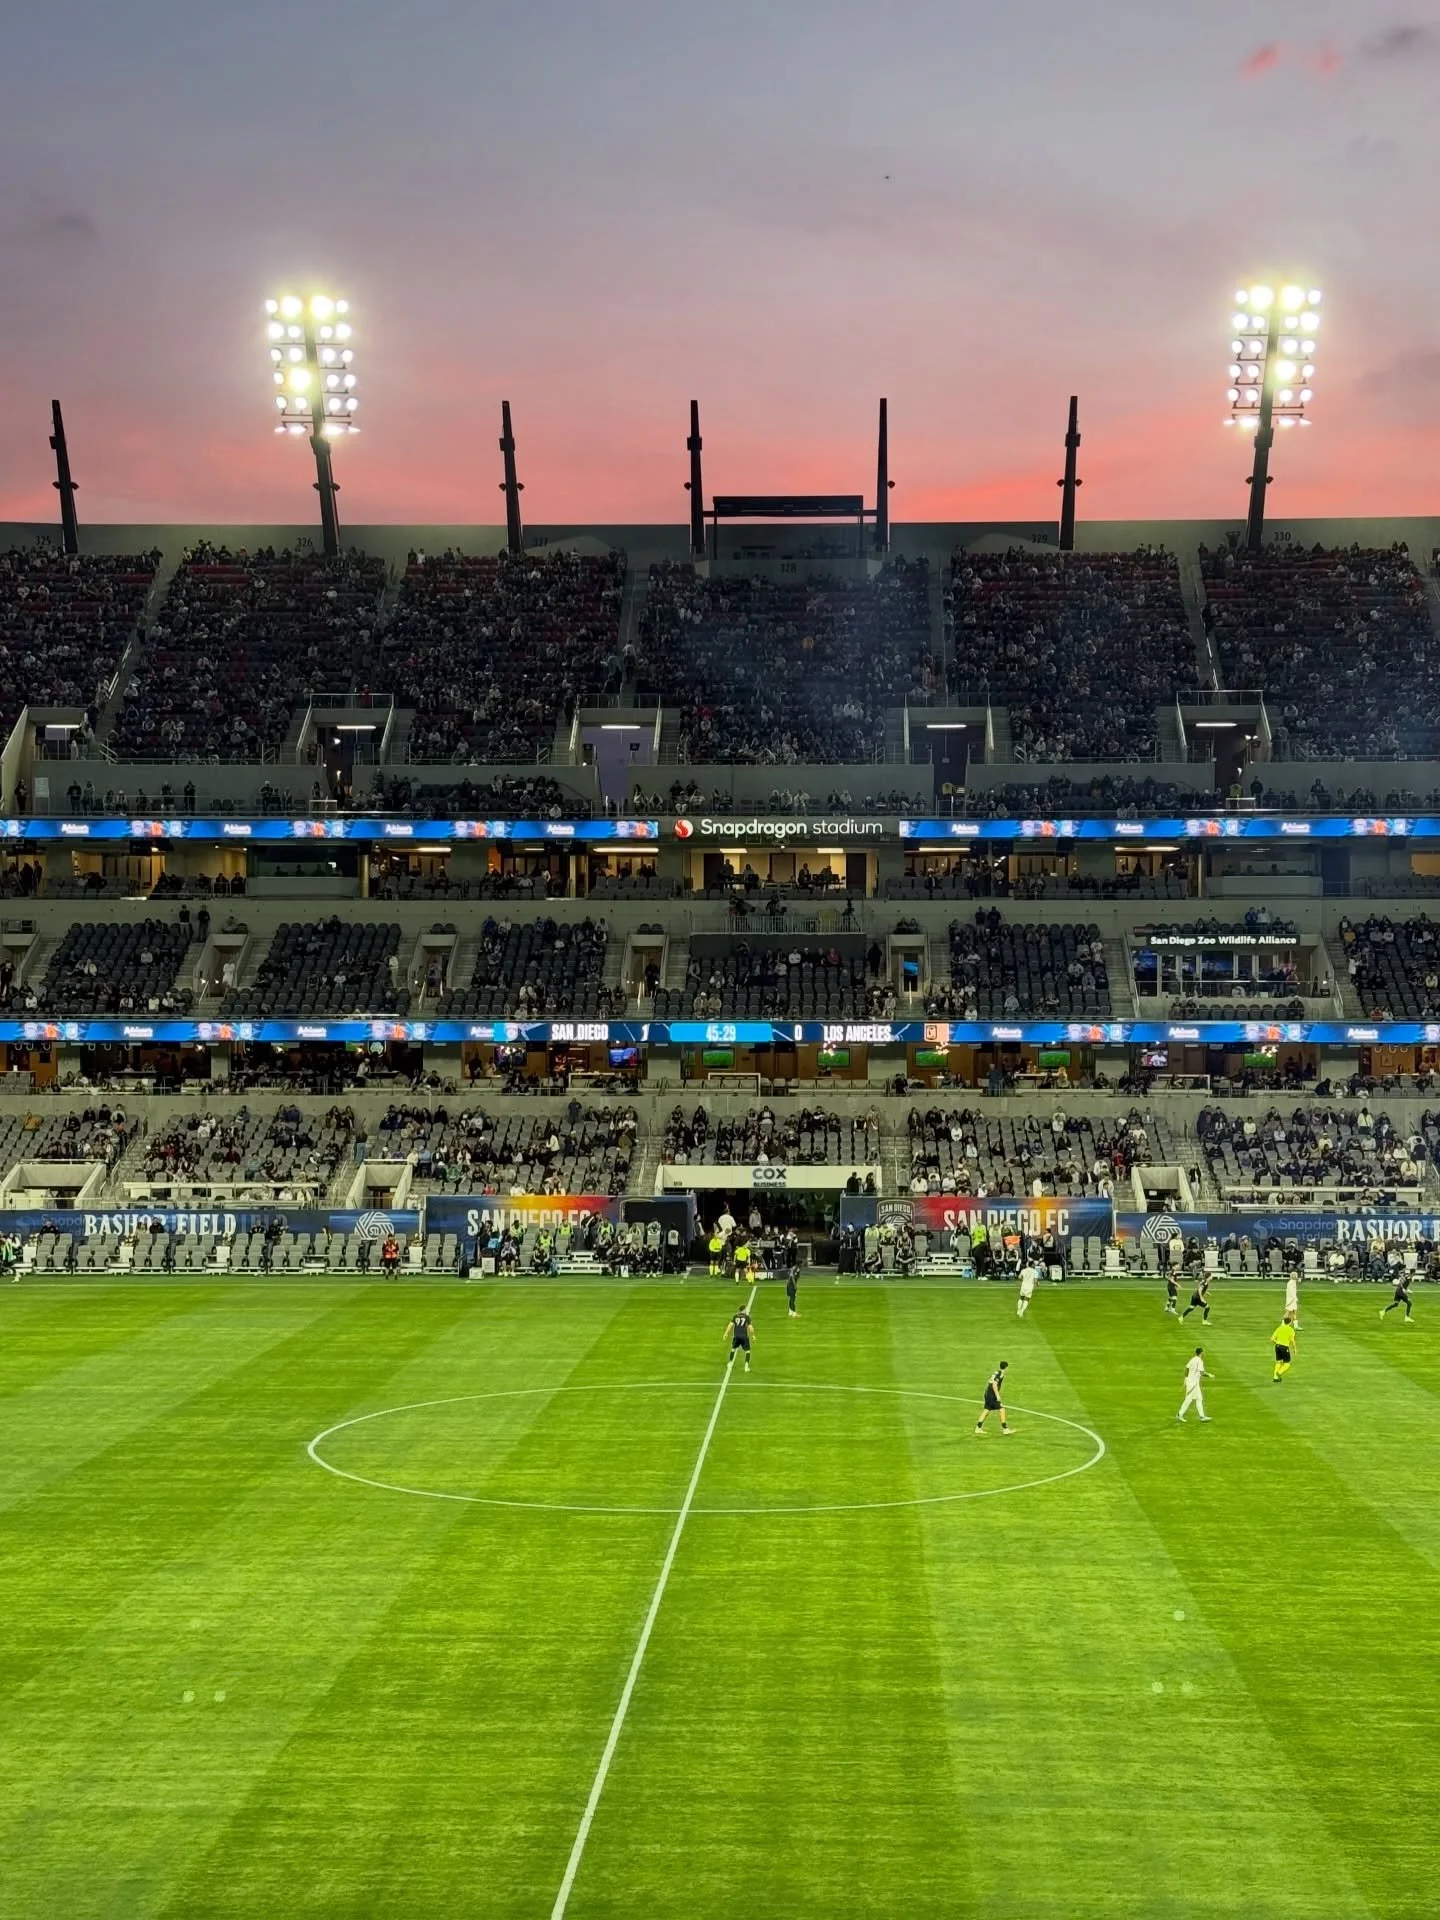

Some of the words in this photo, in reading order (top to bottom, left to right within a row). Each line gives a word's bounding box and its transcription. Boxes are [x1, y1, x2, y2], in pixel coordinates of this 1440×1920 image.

[36, 535, 51, 546] 325
[296, 537, 313, 547] 326
[1274, 531, 1291, 542] 330
[701, 818, 807, 839] Snapdragon
[812, 818, 883, 834] stadium
[1150, 936, 1168, 945] San
[1168, 936, 1196, 946] Diego
[1197, 936, 1216, 945] Zoo
[1218, 935, 1256, 945] Wildlife
[1258, 935, 1297, 945] Alliance
[551, 1023, 574, 1041] SAN
[577, 1023, 609, 1041] DIEGO
[705, 1024, 737, 1042] 45:29
[794, 1024, 803, 1041] 0
[823, 1024, 844, 1042] LOS
[845, 1024, 892, 1042] ANGELES
[752, 1168, 787, 1180] COX
[881, 1204, 893, 1213] SAN
[894, 1204, 911, 1213] DIEGO
[175, 1213, 237, 1236] FIELD
[1046, 1208, 1069, 1236] FC
[1156, 1230, 1167, 1240] SD
[1336, 1219, 1422, 1242] BASHOR
[735, 1317, 746, 1326] 97
